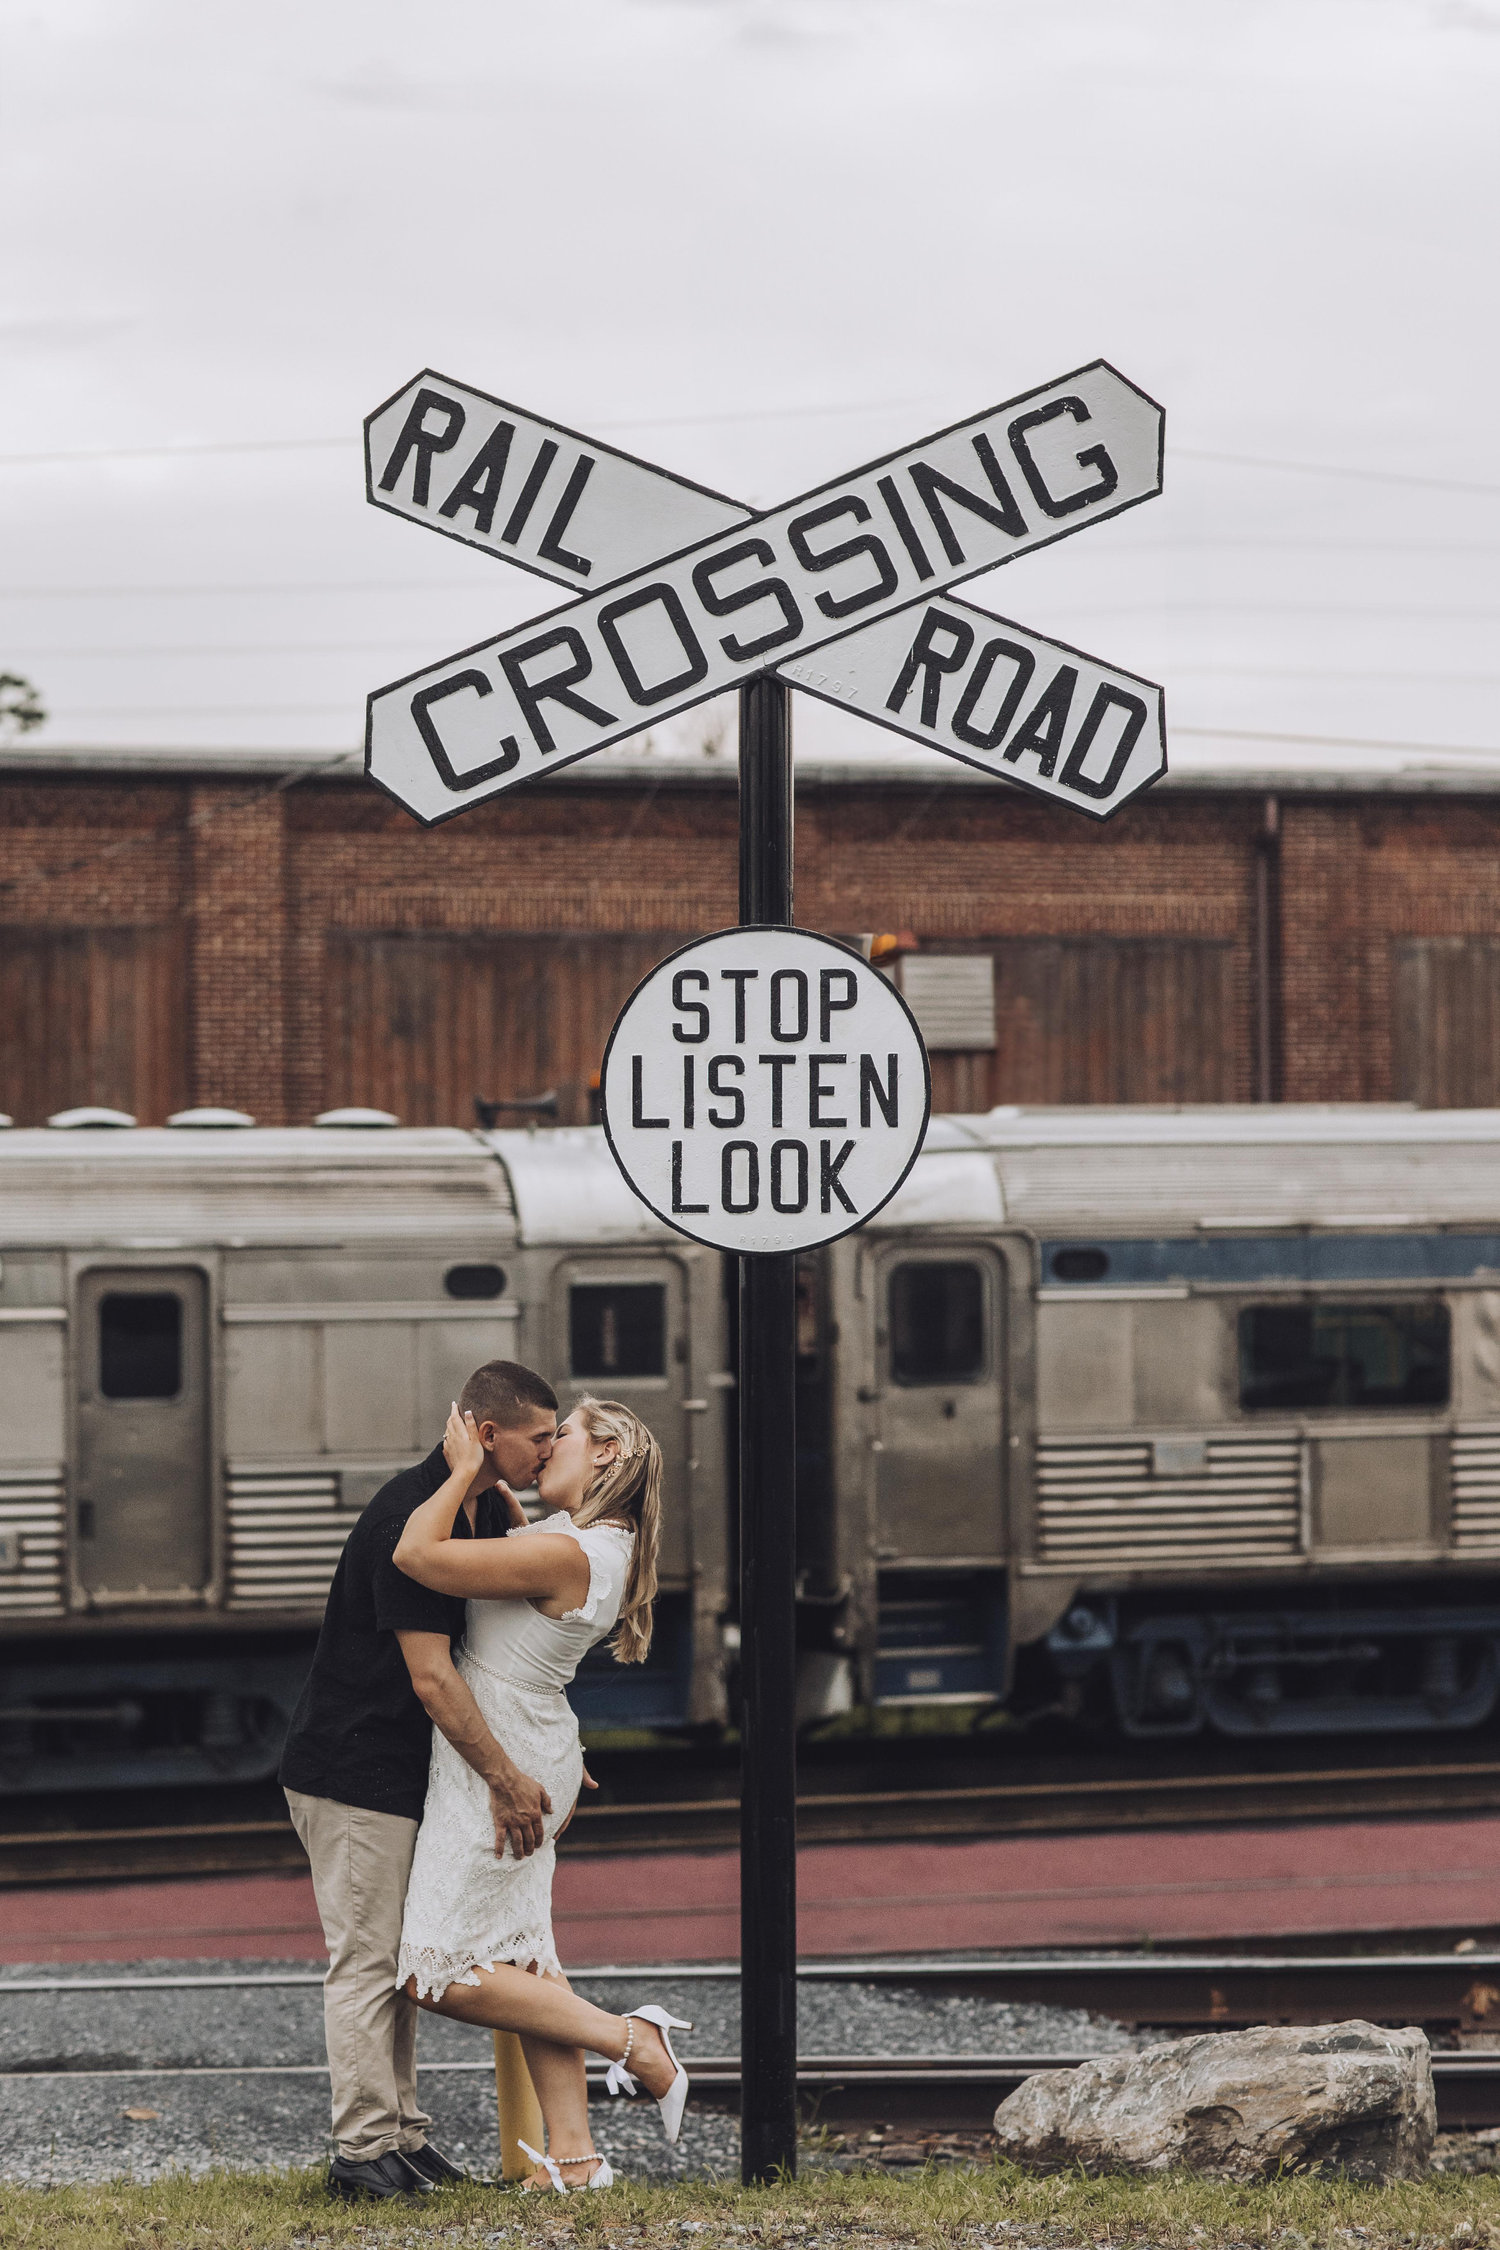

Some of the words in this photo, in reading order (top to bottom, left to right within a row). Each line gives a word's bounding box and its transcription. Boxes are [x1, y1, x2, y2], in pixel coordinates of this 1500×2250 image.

[378, 388, 595, 577] RAIL
[410, 396, 1119, 792] CROSSING
[885, 606, 1148, 800] ROAD
[672, 968, 858, 1044] STOP
[631, 1053, 899, 1129] LISTEN
[671, 1139, 859, 1215] LOOK
